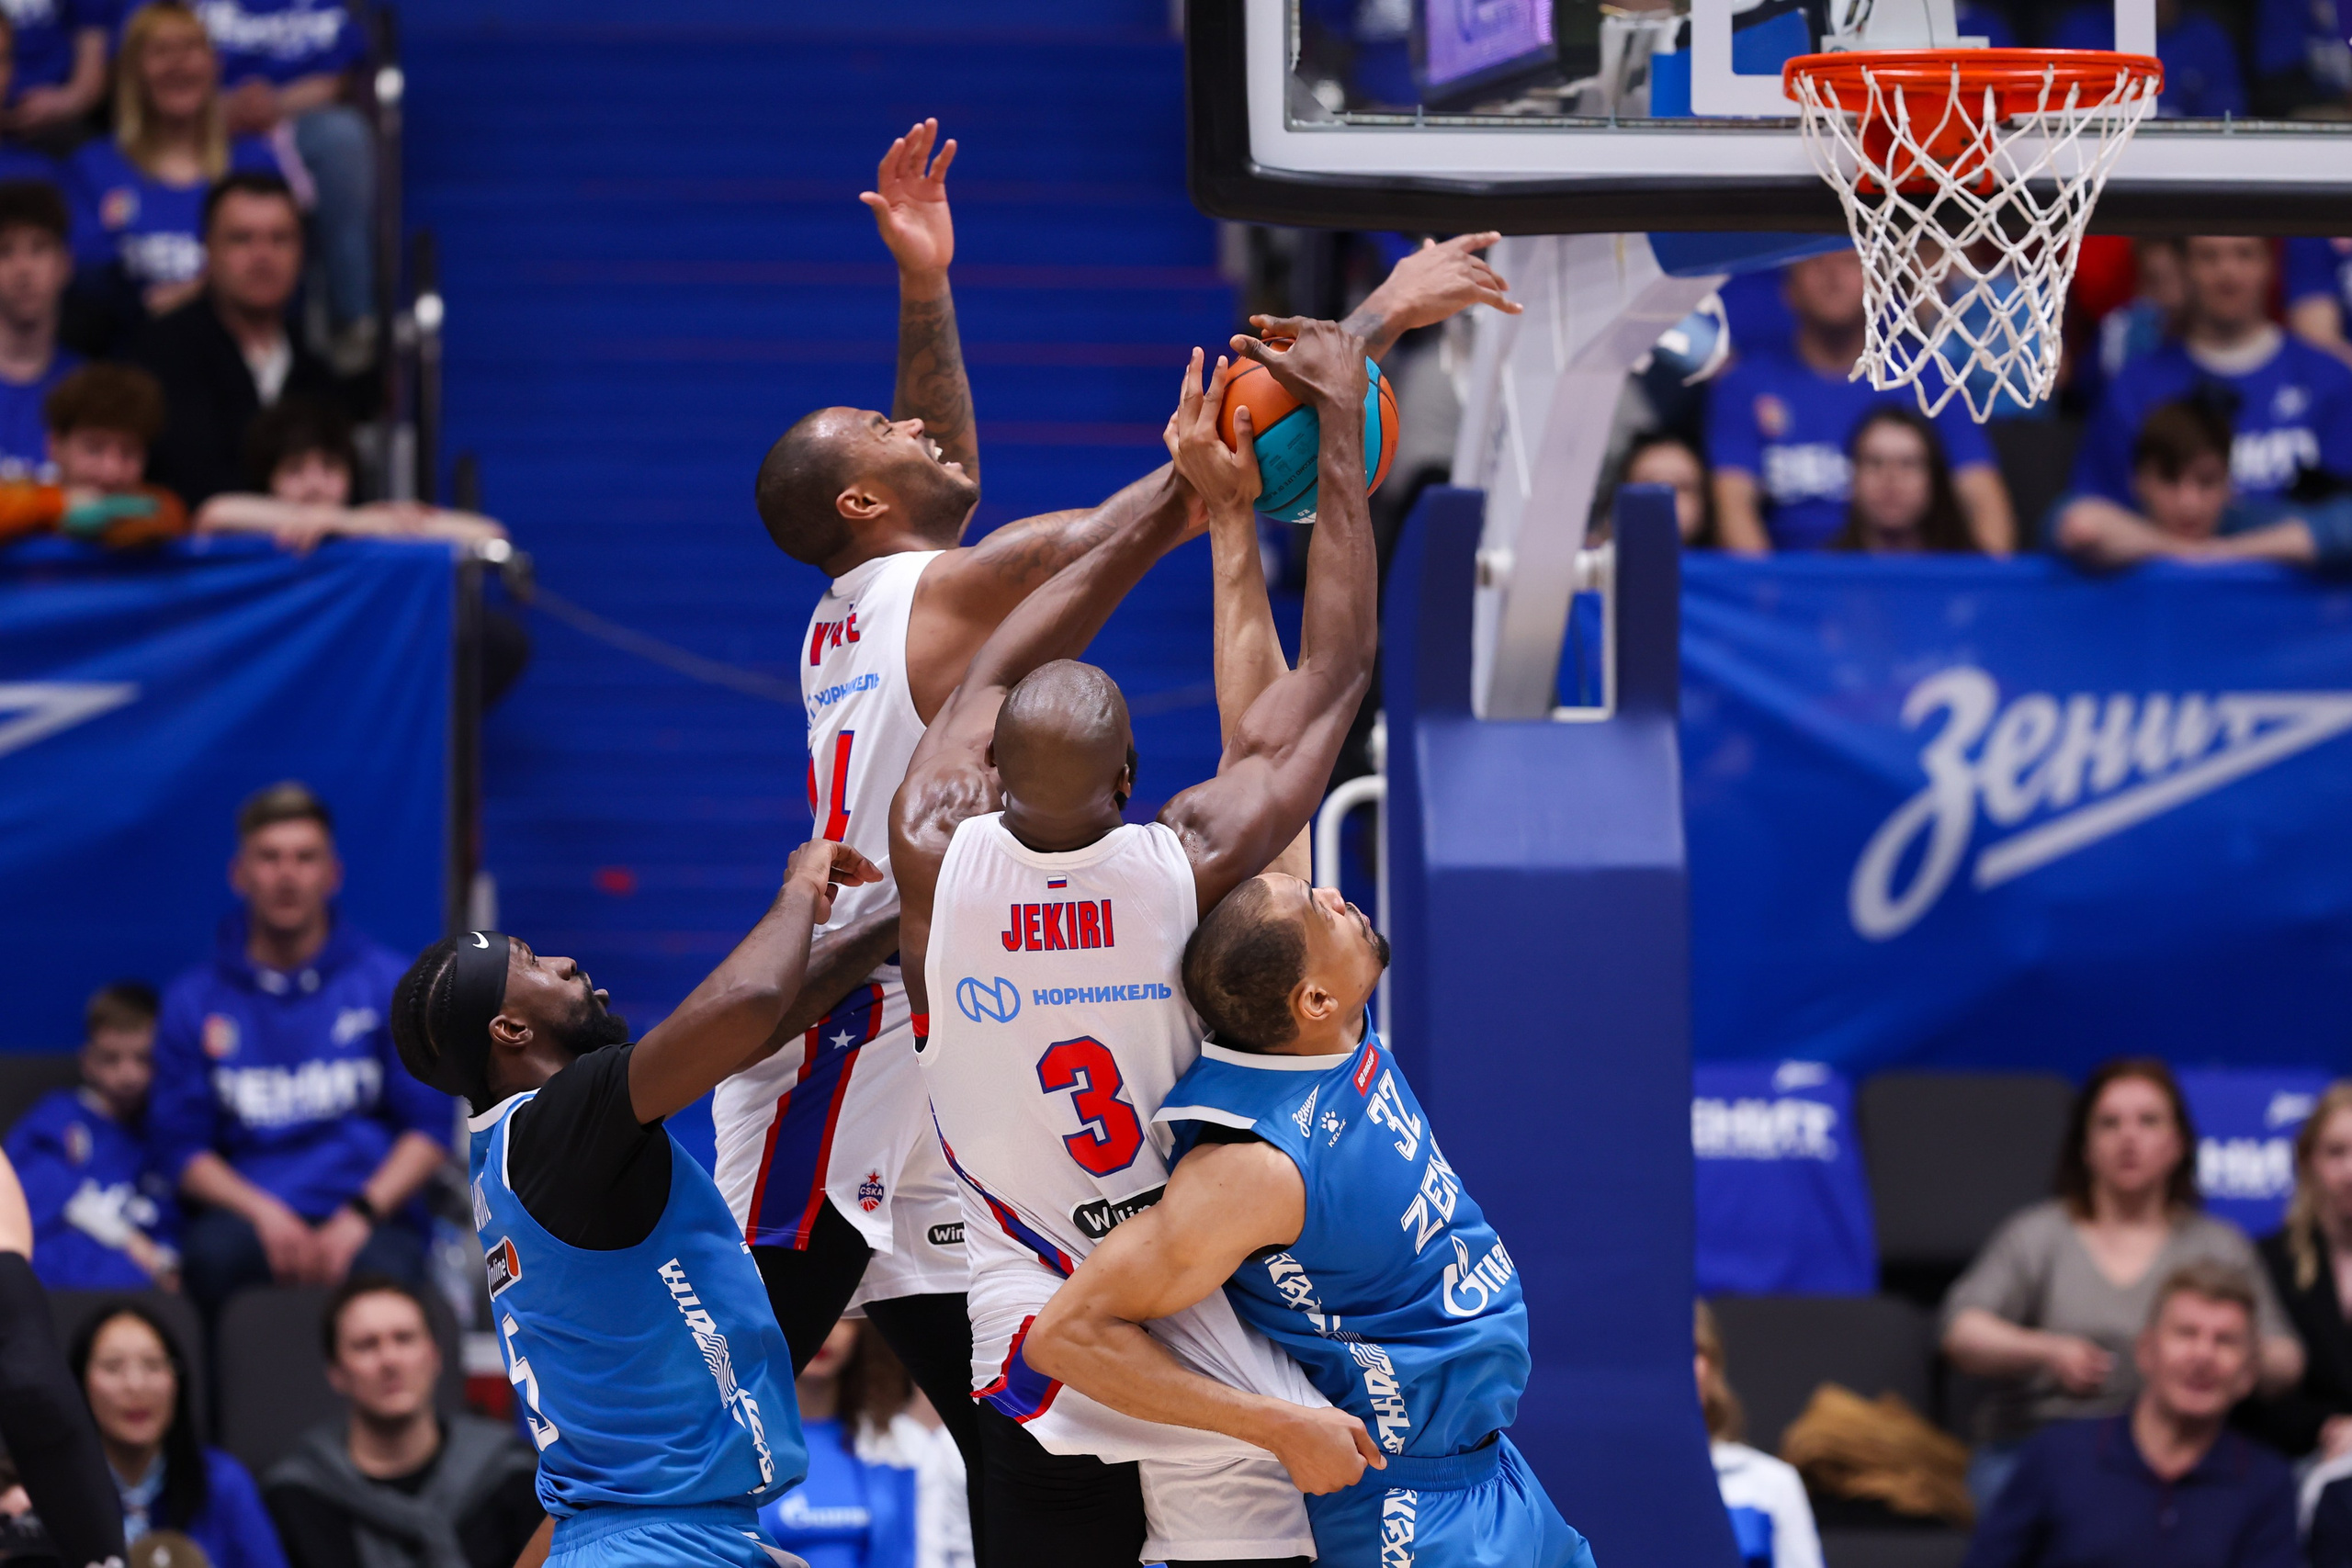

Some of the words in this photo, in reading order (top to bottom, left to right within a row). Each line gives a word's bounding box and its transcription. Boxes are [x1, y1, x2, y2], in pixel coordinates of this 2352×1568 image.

[1001, 898, 1114, 953] JEKIRI
[1032, 982, 1172, 1006] НОРНИКЕЛЬ
[1035, 1035, 1146, 1179] 3
[1328, 1118, 1347, 1148] KELME
[1366, 1068, 1422, 1162] 32
[859, 1186, 883, 1197] CSKA
[1400, 1128, 1460, 1257] ZEN
[502, 1312, 560, 1452] 5
